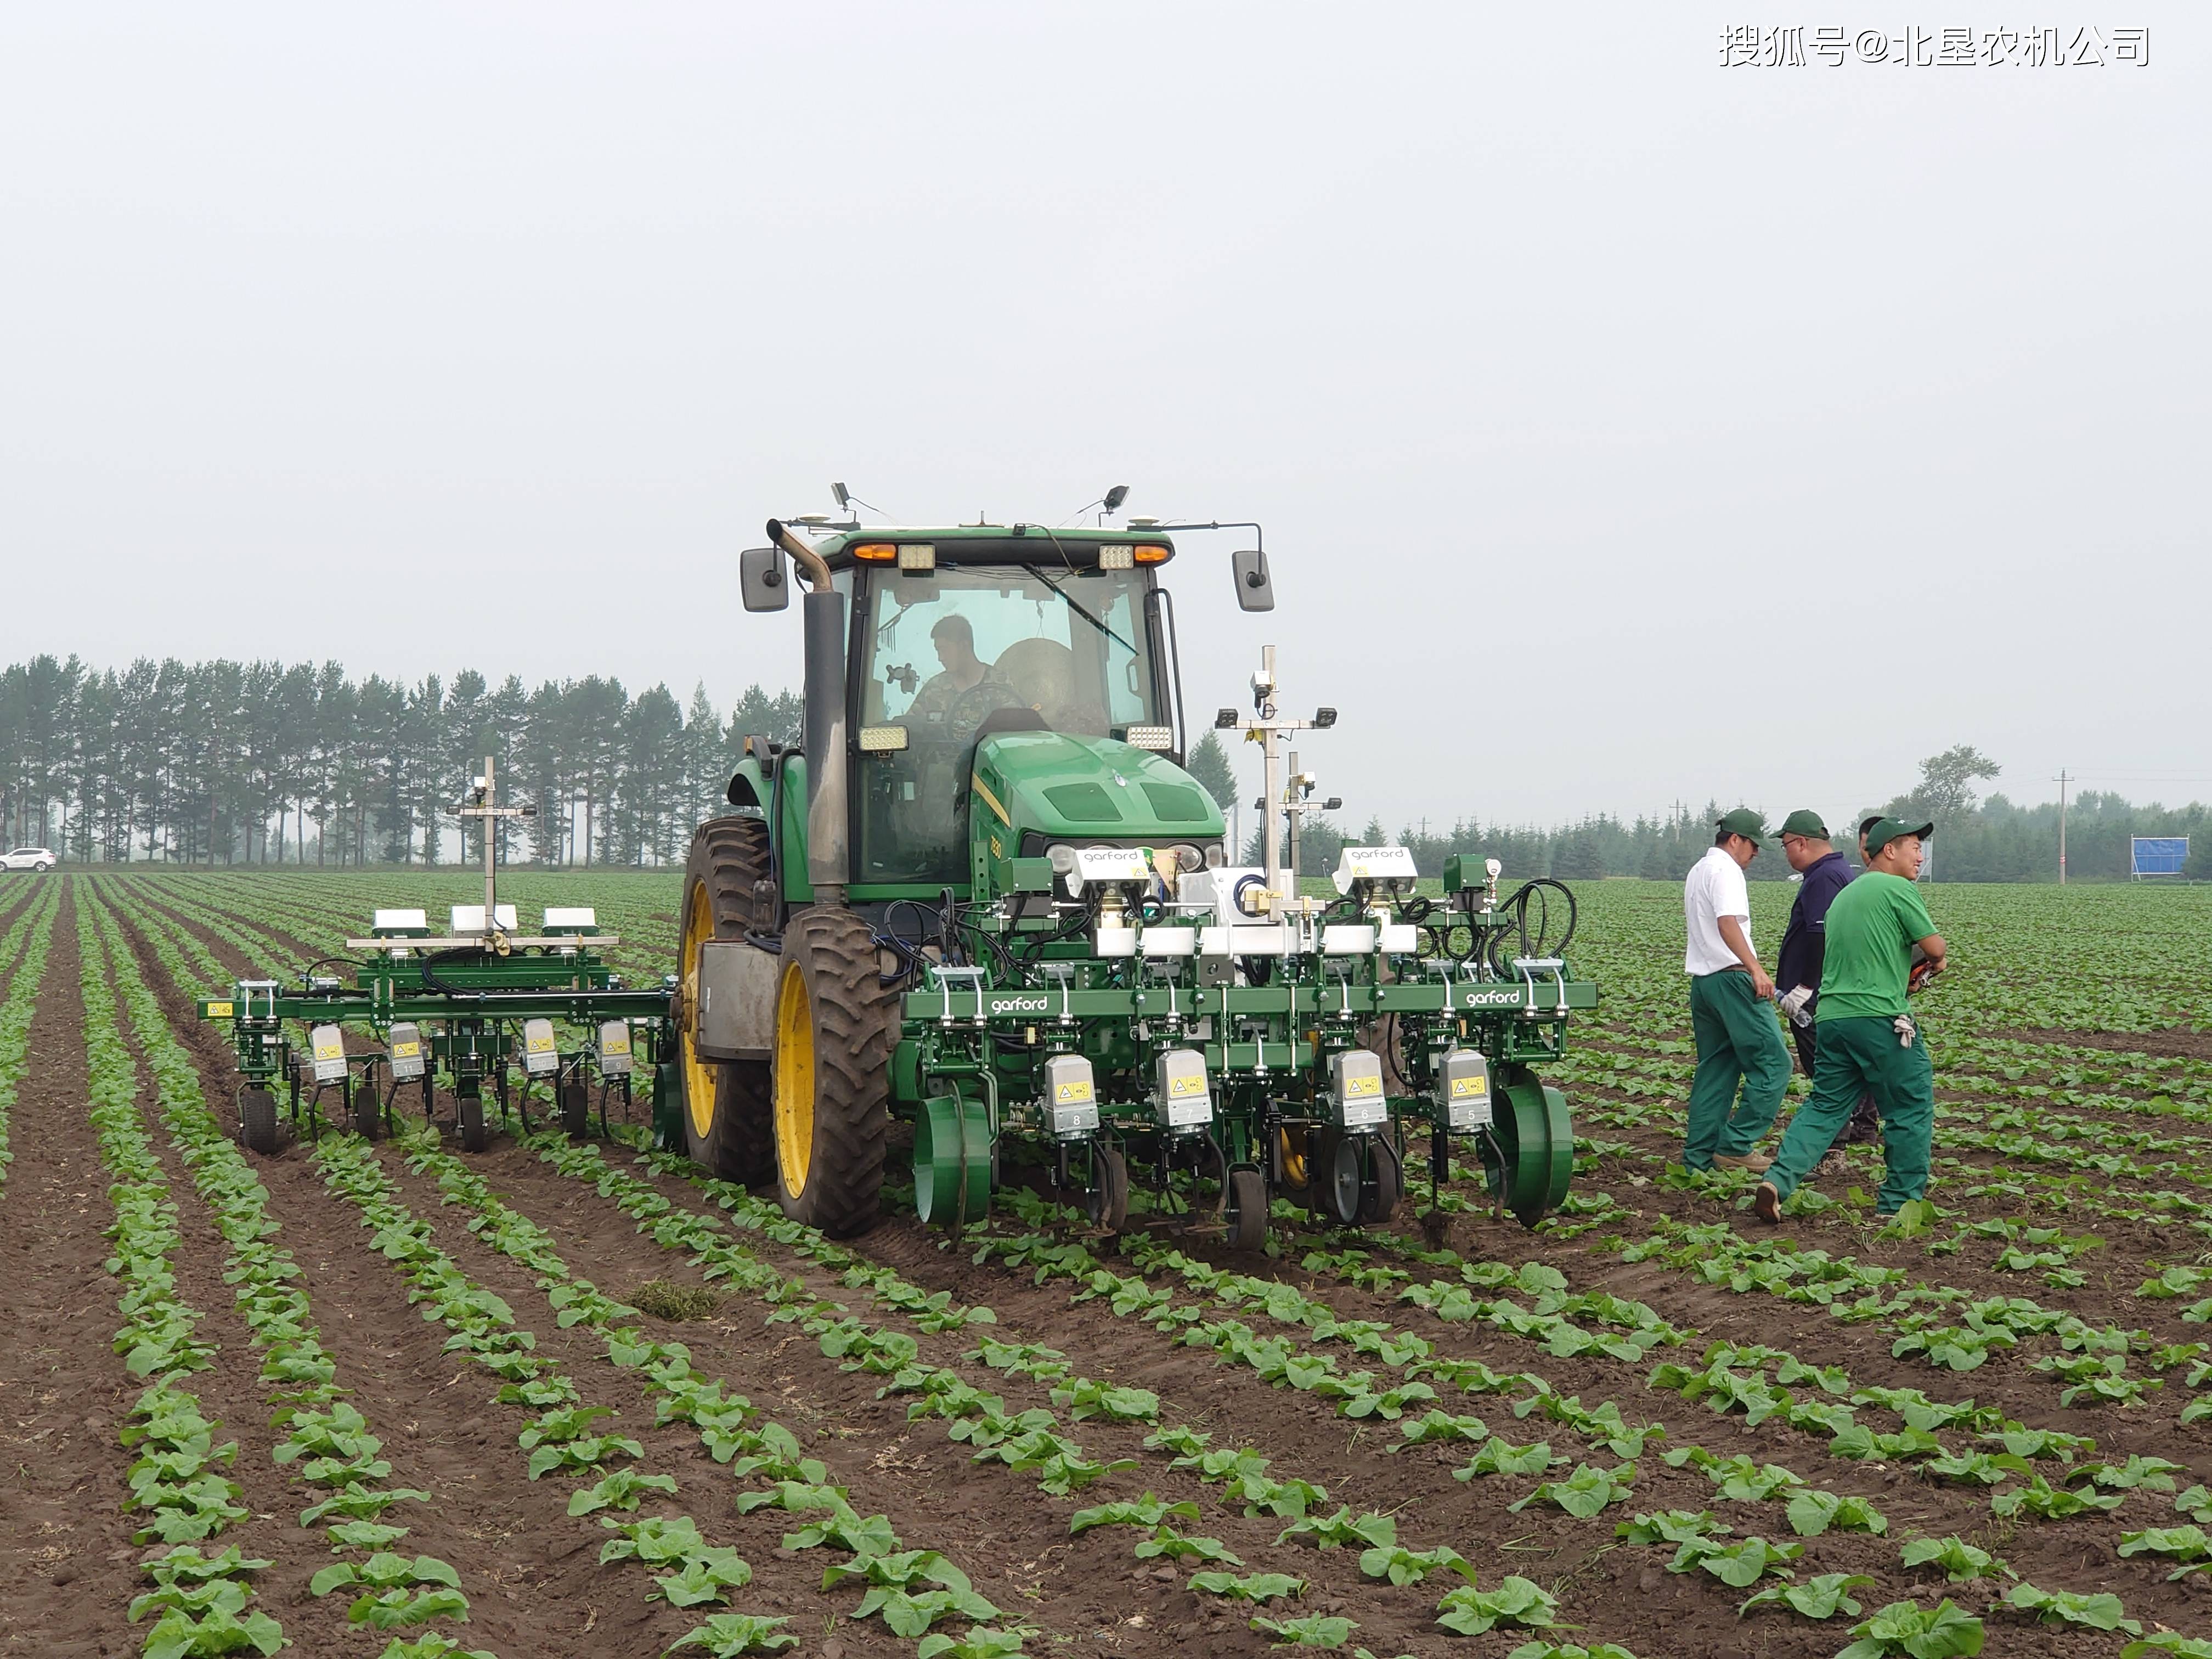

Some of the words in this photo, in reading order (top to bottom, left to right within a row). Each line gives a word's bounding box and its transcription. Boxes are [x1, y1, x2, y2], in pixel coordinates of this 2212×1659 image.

[1084, 851, 1138, 862] garford
[1352, 849, 1404, 860] garford
[1466, 990, 1520, 1007] garford
[991, 996, 1047, 1014] garford
[404, 1065, 413, 1073] 11
[1186, 1109, 1193, 1119] 7
[1362, 1109, 1368, 1119] 6
[1468, 1110, 1475, 1120] 5
[1074, 1115, 1080, 1125] 8
